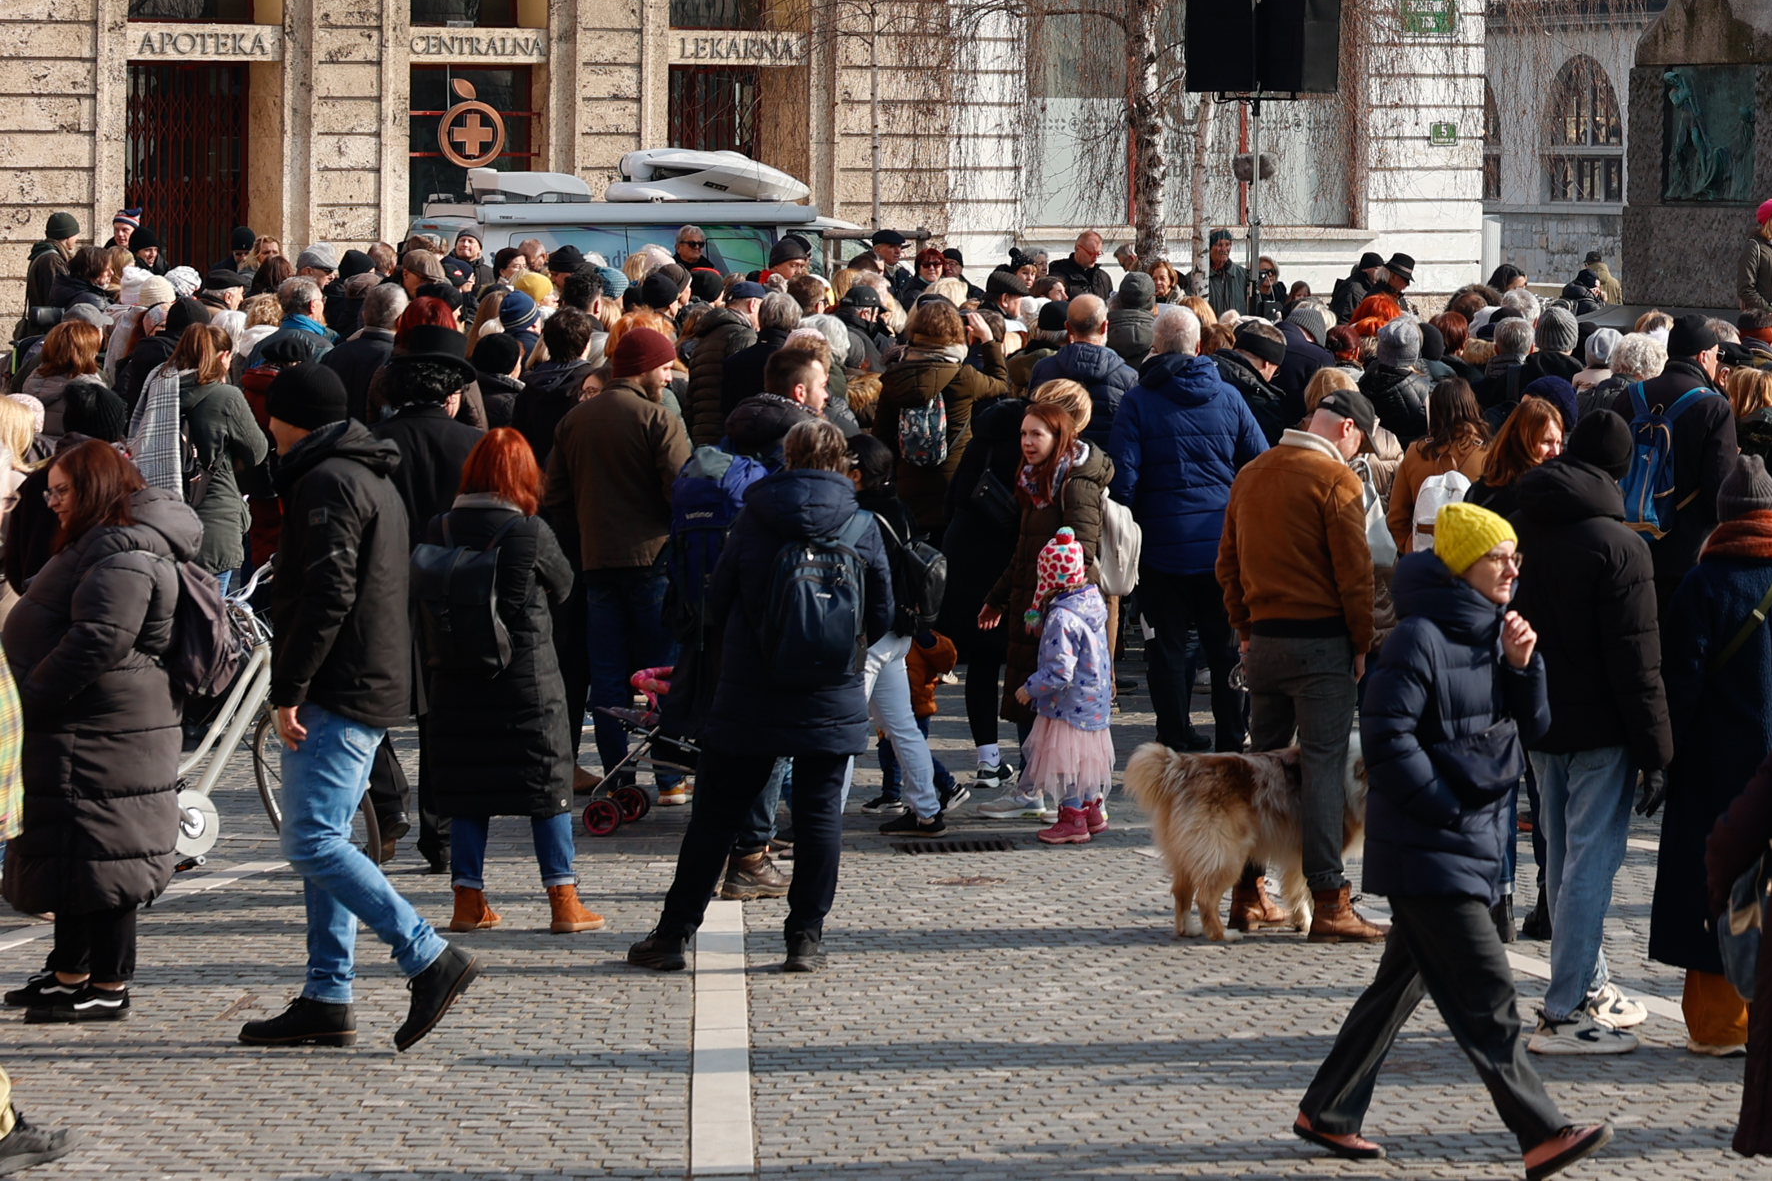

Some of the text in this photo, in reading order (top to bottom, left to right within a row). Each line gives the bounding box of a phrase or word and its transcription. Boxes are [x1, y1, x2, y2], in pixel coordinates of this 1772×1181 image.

[138, 32, 269, 55] APOTEKA
[411, 35, 546, 56] CENTRALNA
[679, 37, 799, 60] LEKARNA
[1441, 125, 1447, 137] 5
